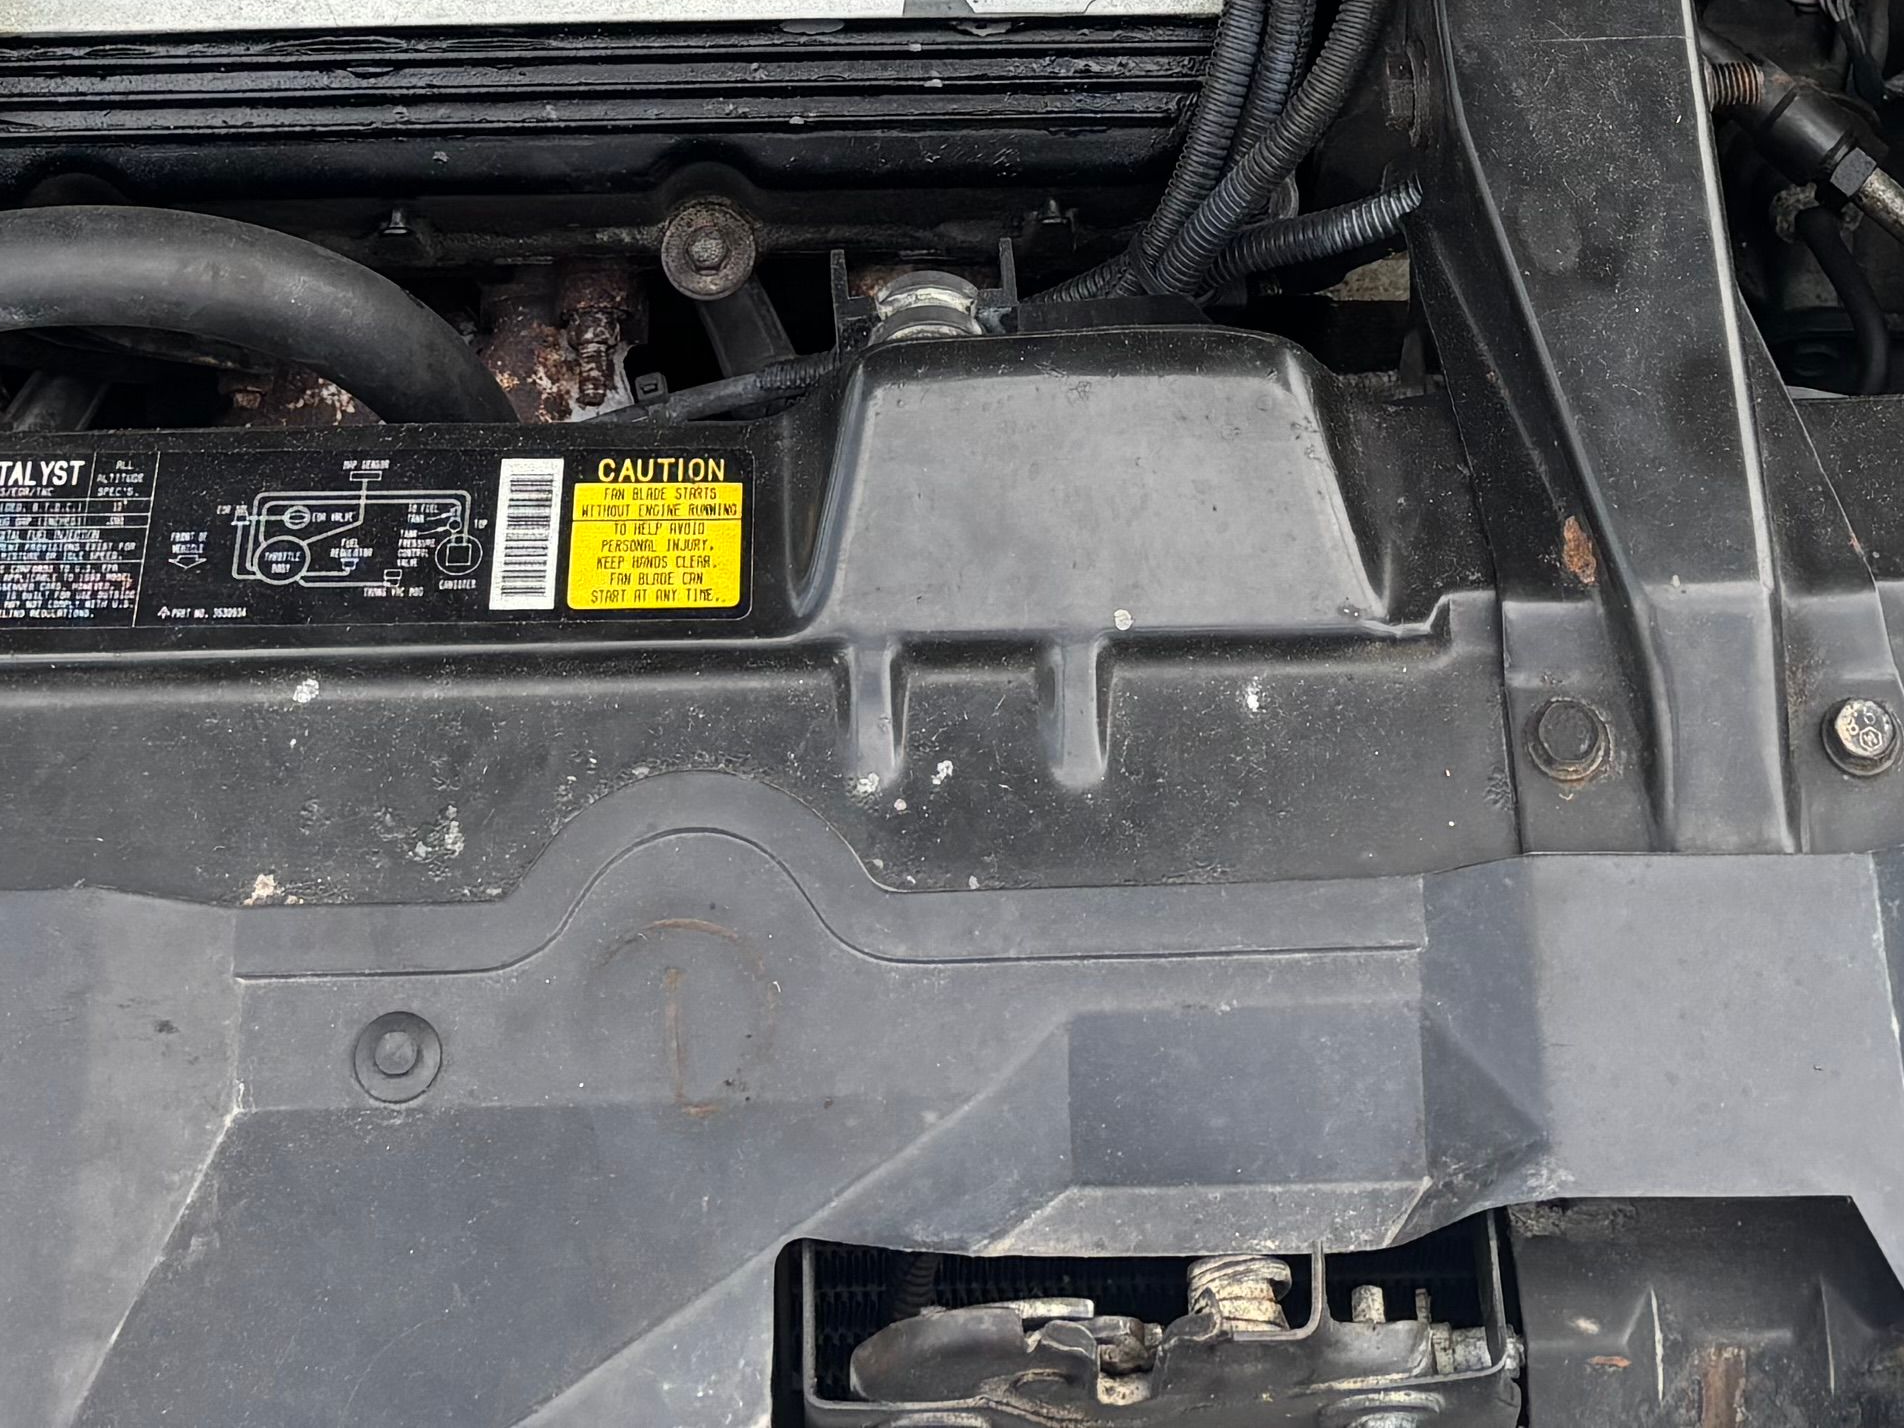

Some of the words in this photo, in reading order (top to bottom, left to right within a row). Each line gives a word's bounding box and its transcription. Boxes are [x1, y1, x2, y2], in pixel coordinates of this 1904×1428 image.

[597, 458, 725, 483] CAUTION
[603, 487, 625, 500] FAN
[632, 487, 667, 500] BLADE
[675, 487, 717, 500] STARTS
[581, 504, 631, 517] WITHOUT
[638, 504, 682, 517] ENGINE
[688, 503, 738, 516] RUNNING
[614, 522, 626, 535] TO
[633, 522, 663, 535] HELP
[669, 522, 705, 535] AVOID
[600, 539, 657, 552] PERSONAL
[596, 556, 625, 569] KEEP
[632, 556, 668, 569] HANDS
[609, 572, 632, 585] FAN
[638, 572, 675, 585] BLADE
[682, 572, 704, 585] CAN
[590, 590, 626, 603] START
[634, 590, 648, 602] AT
[655, 589, 678, 602] ANY
